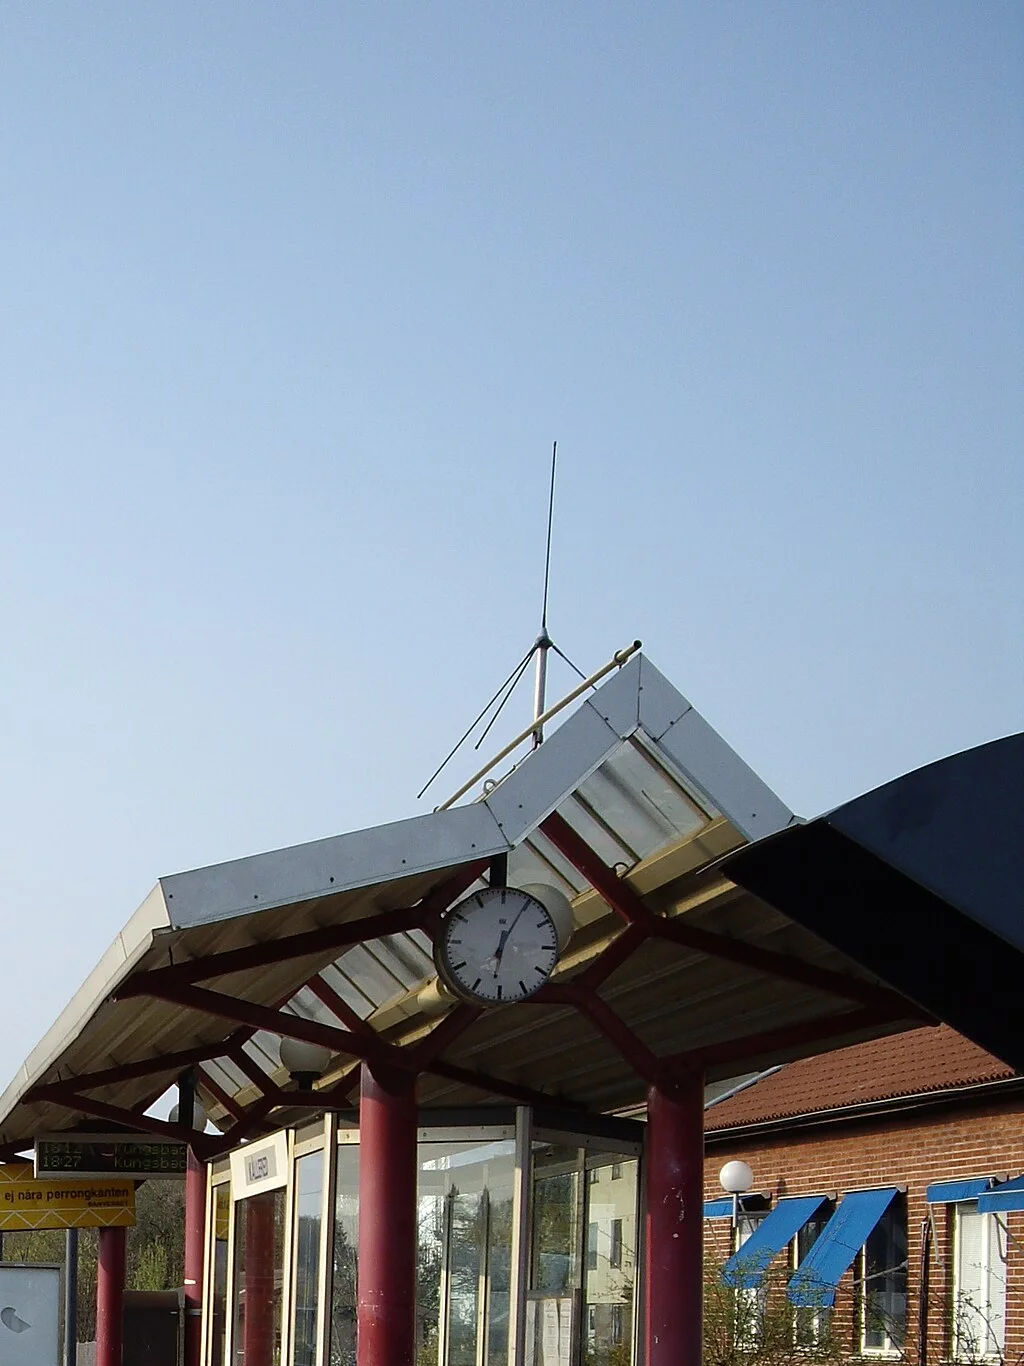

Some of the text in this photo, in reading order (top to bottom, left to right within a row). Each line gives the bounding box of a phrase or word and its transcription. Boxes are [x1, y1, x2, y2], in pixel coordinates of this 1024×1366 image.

[4, 1191, 14, 1203] ej
[18, 1189, 43, 1200] nära
[46, 1187, 129, 1202] perrongkanten
